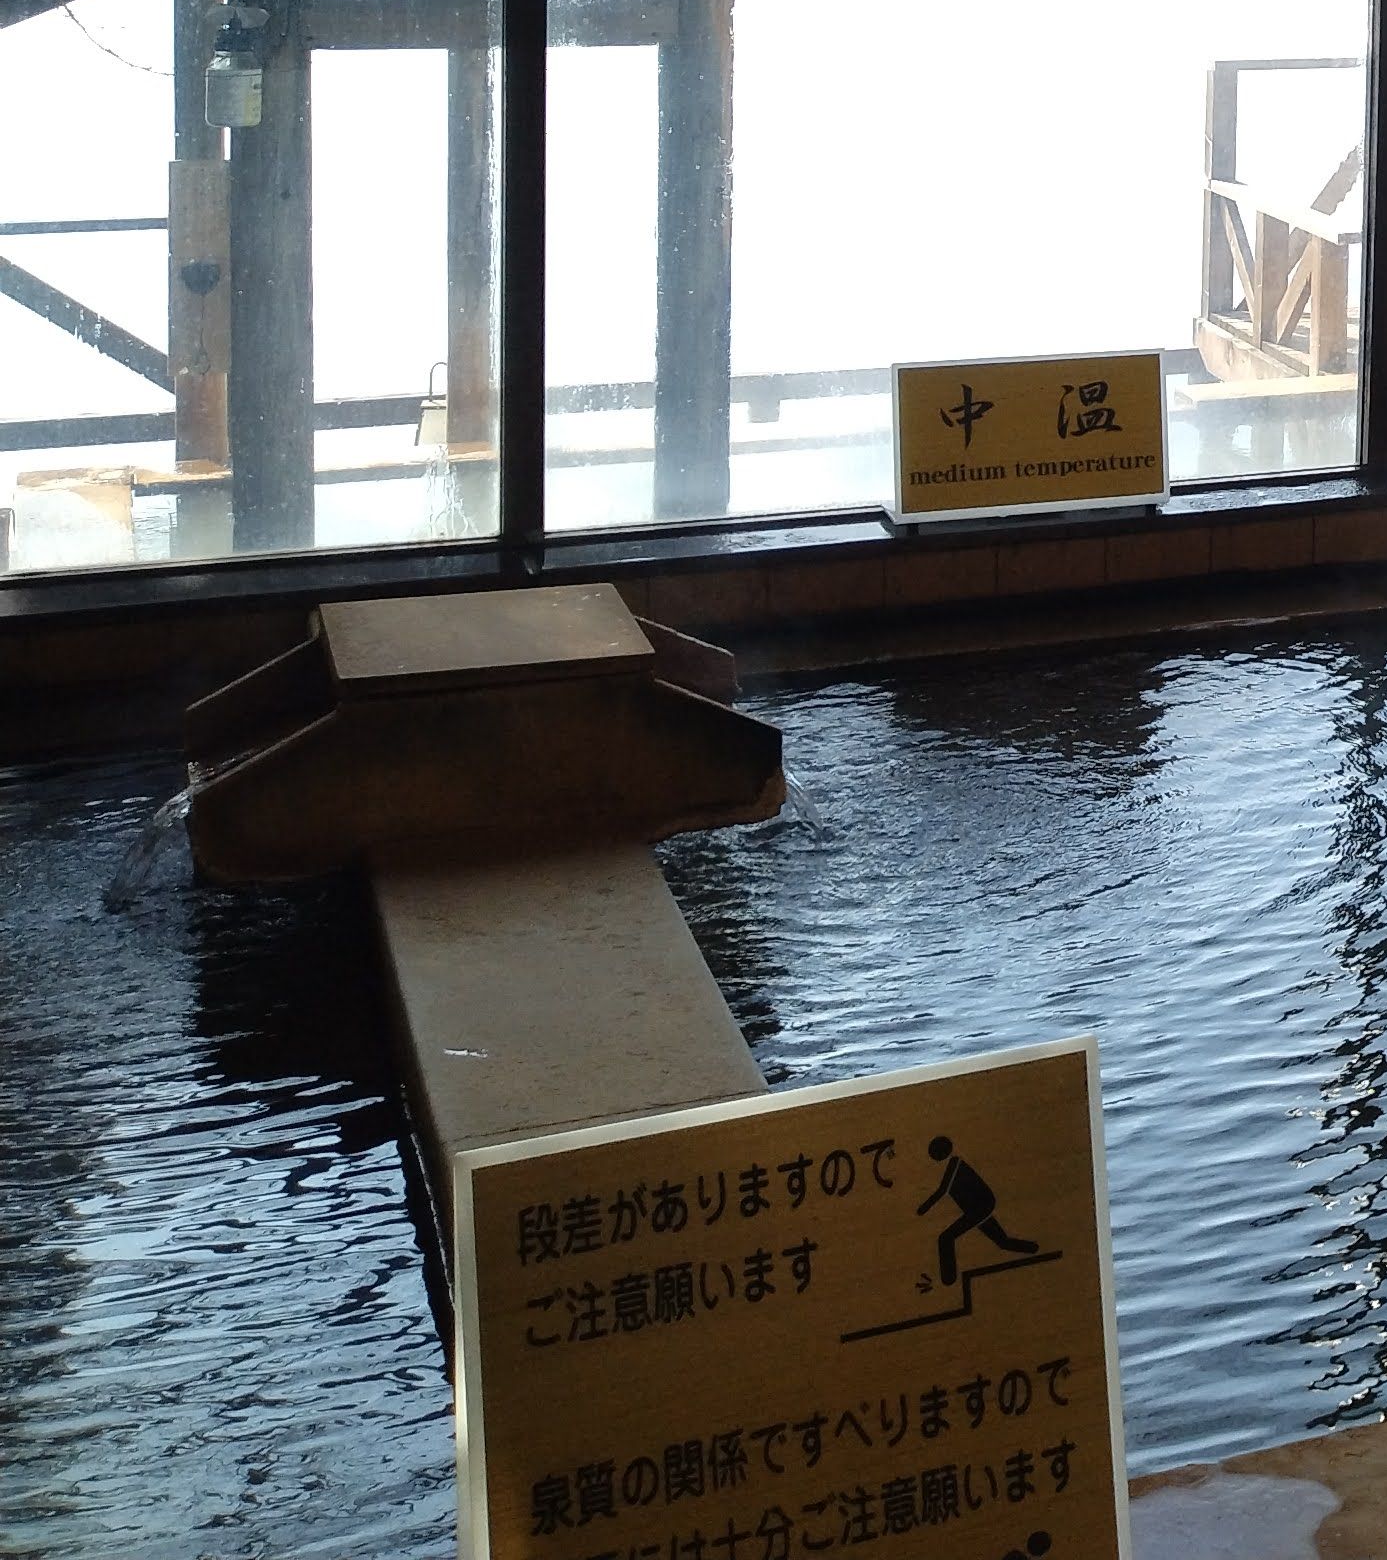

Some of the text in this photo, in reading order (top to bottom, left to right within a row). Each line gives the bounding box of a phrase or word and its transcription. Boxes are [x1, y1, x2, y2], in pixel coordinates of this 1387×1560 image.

[909, 453, 1156, 486] medium temperature
[938, 380, 1124, 450] 中温
[517, 1139, 896, 1266] 段差がありますので
[526, 1238, 819, 1347] ご注意願います
[530, 1356, 1071, 1537] 泉質の関係ですべりますので
